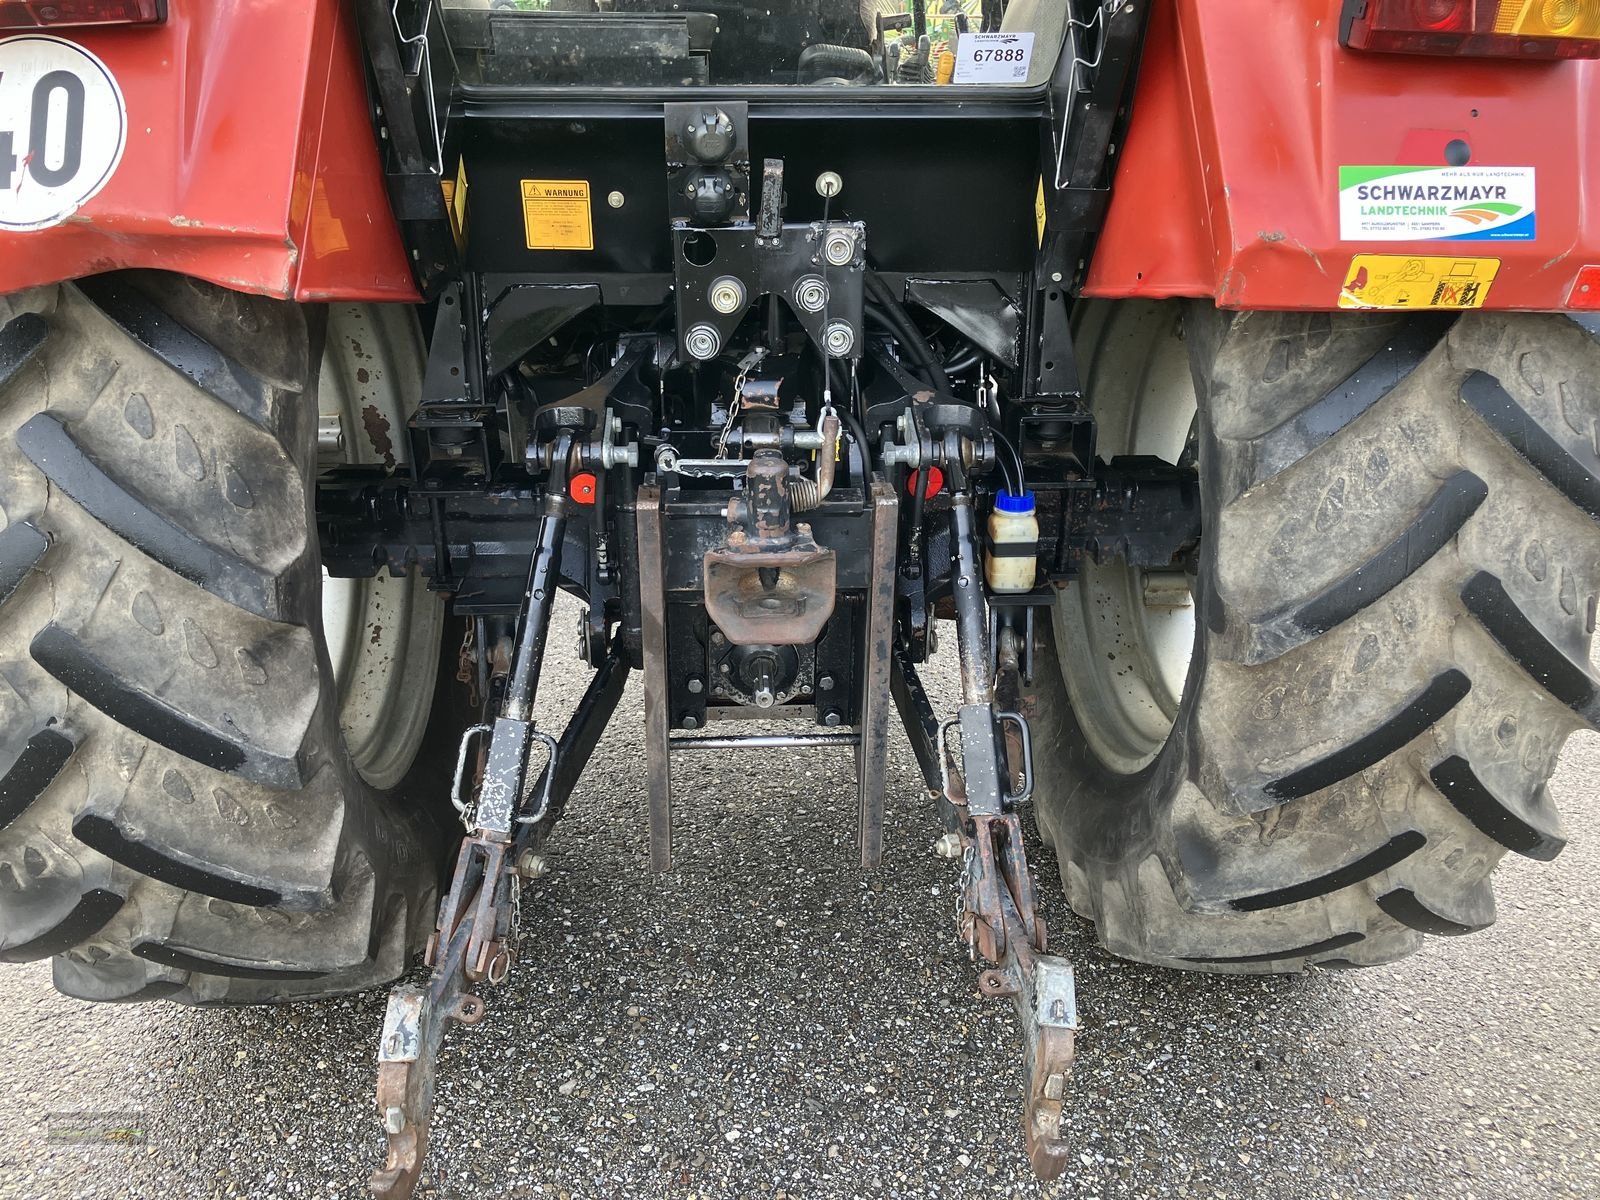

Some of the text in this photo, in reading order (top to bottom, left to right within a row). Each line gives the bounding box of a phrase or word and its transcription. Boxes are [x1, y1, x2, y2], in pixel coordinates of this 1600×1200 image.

[974, 49, 1024, 62] 67888
[544, 189, 584, 197] WARNUNG
[1357, 185, 1507, 200] SCHWARZMAYR
[1361, 206, 1447, 216] LANDTECHNIK
